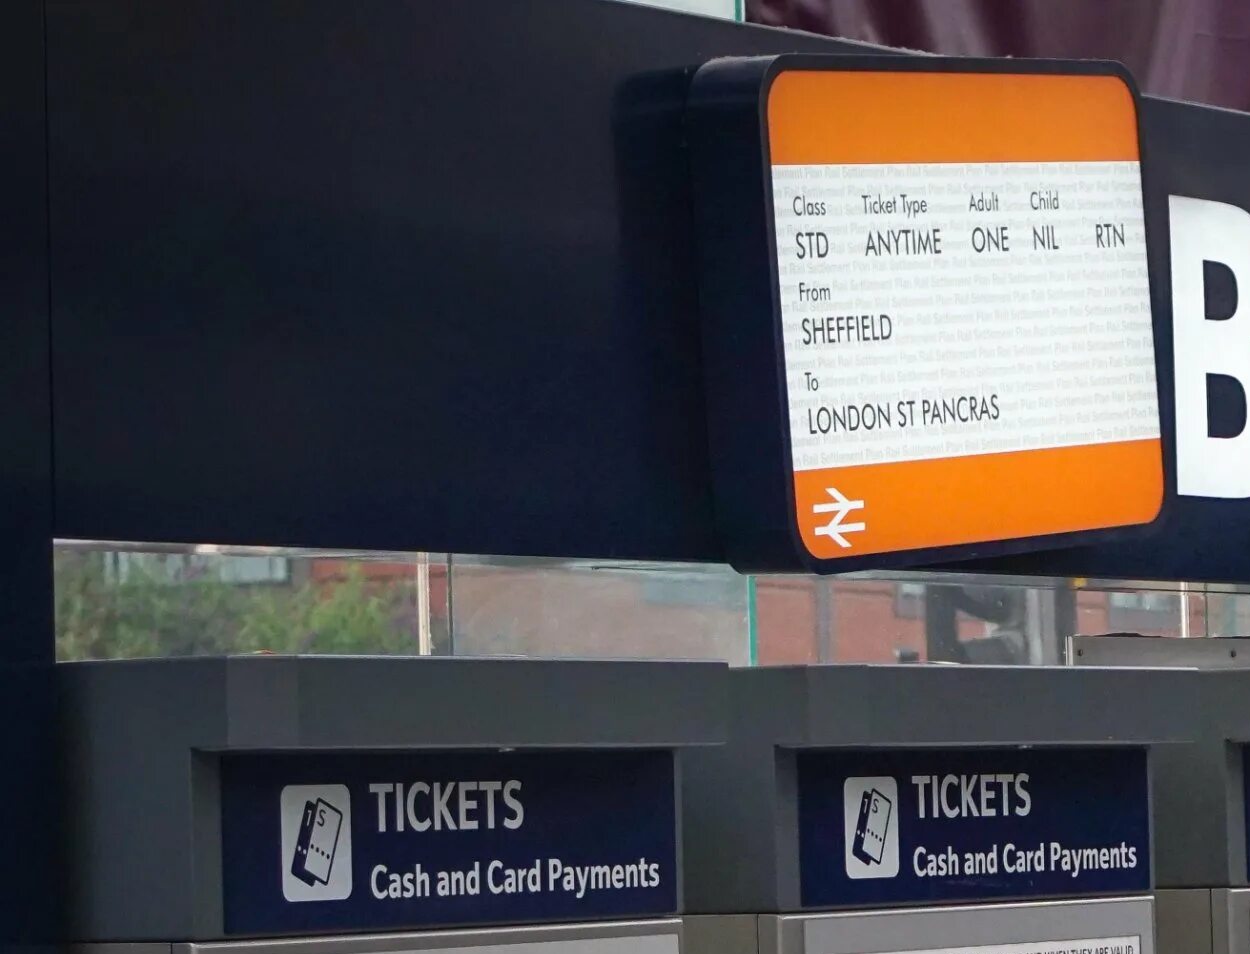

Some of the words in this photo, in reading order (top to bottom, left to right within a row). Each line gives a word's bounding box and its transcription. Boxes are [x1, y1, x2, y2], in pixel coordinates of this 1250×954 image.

[793, 195, 826, 216] Class
[862, 194, 897, 215] Ticket
[900, 194, 928, 218] Type
[969, 192, 999, 212] Adult
[1030, 190, 1059, 211] Child
[795, 232, 829, 260] STD
[865, 229, 942, 256] ANYTIME
[971, 227, 1009, 253] ONE
[1032, 224, 1060, 250] NIL
[1095, 223, 1126, 249] RTN
[799, 282, 831, 301] From
[801, 314, 892, 345] SHEFFIELD
[804, 372, 819, 391] To
[808, 402, 892, 435] LONDON
[897, 400, 916, 428] ST
[921, 394, 1000, 426] PANCRAS
[369, 779, 524, 832] TICKETS
[911, 772, 1032, 819] TICKETS
[370, 864, 431, 900] Cash
[437, 862, 480, 897] and
[487, 857, 542, 894] Card
[548, 856, 660, 898] Payments
[913, 846, 960, 878] Cash
[964, 844, 998, 876] and
[1003, 842, 1045, 874] Card
[1050, 841, 1138, 877] Payments
